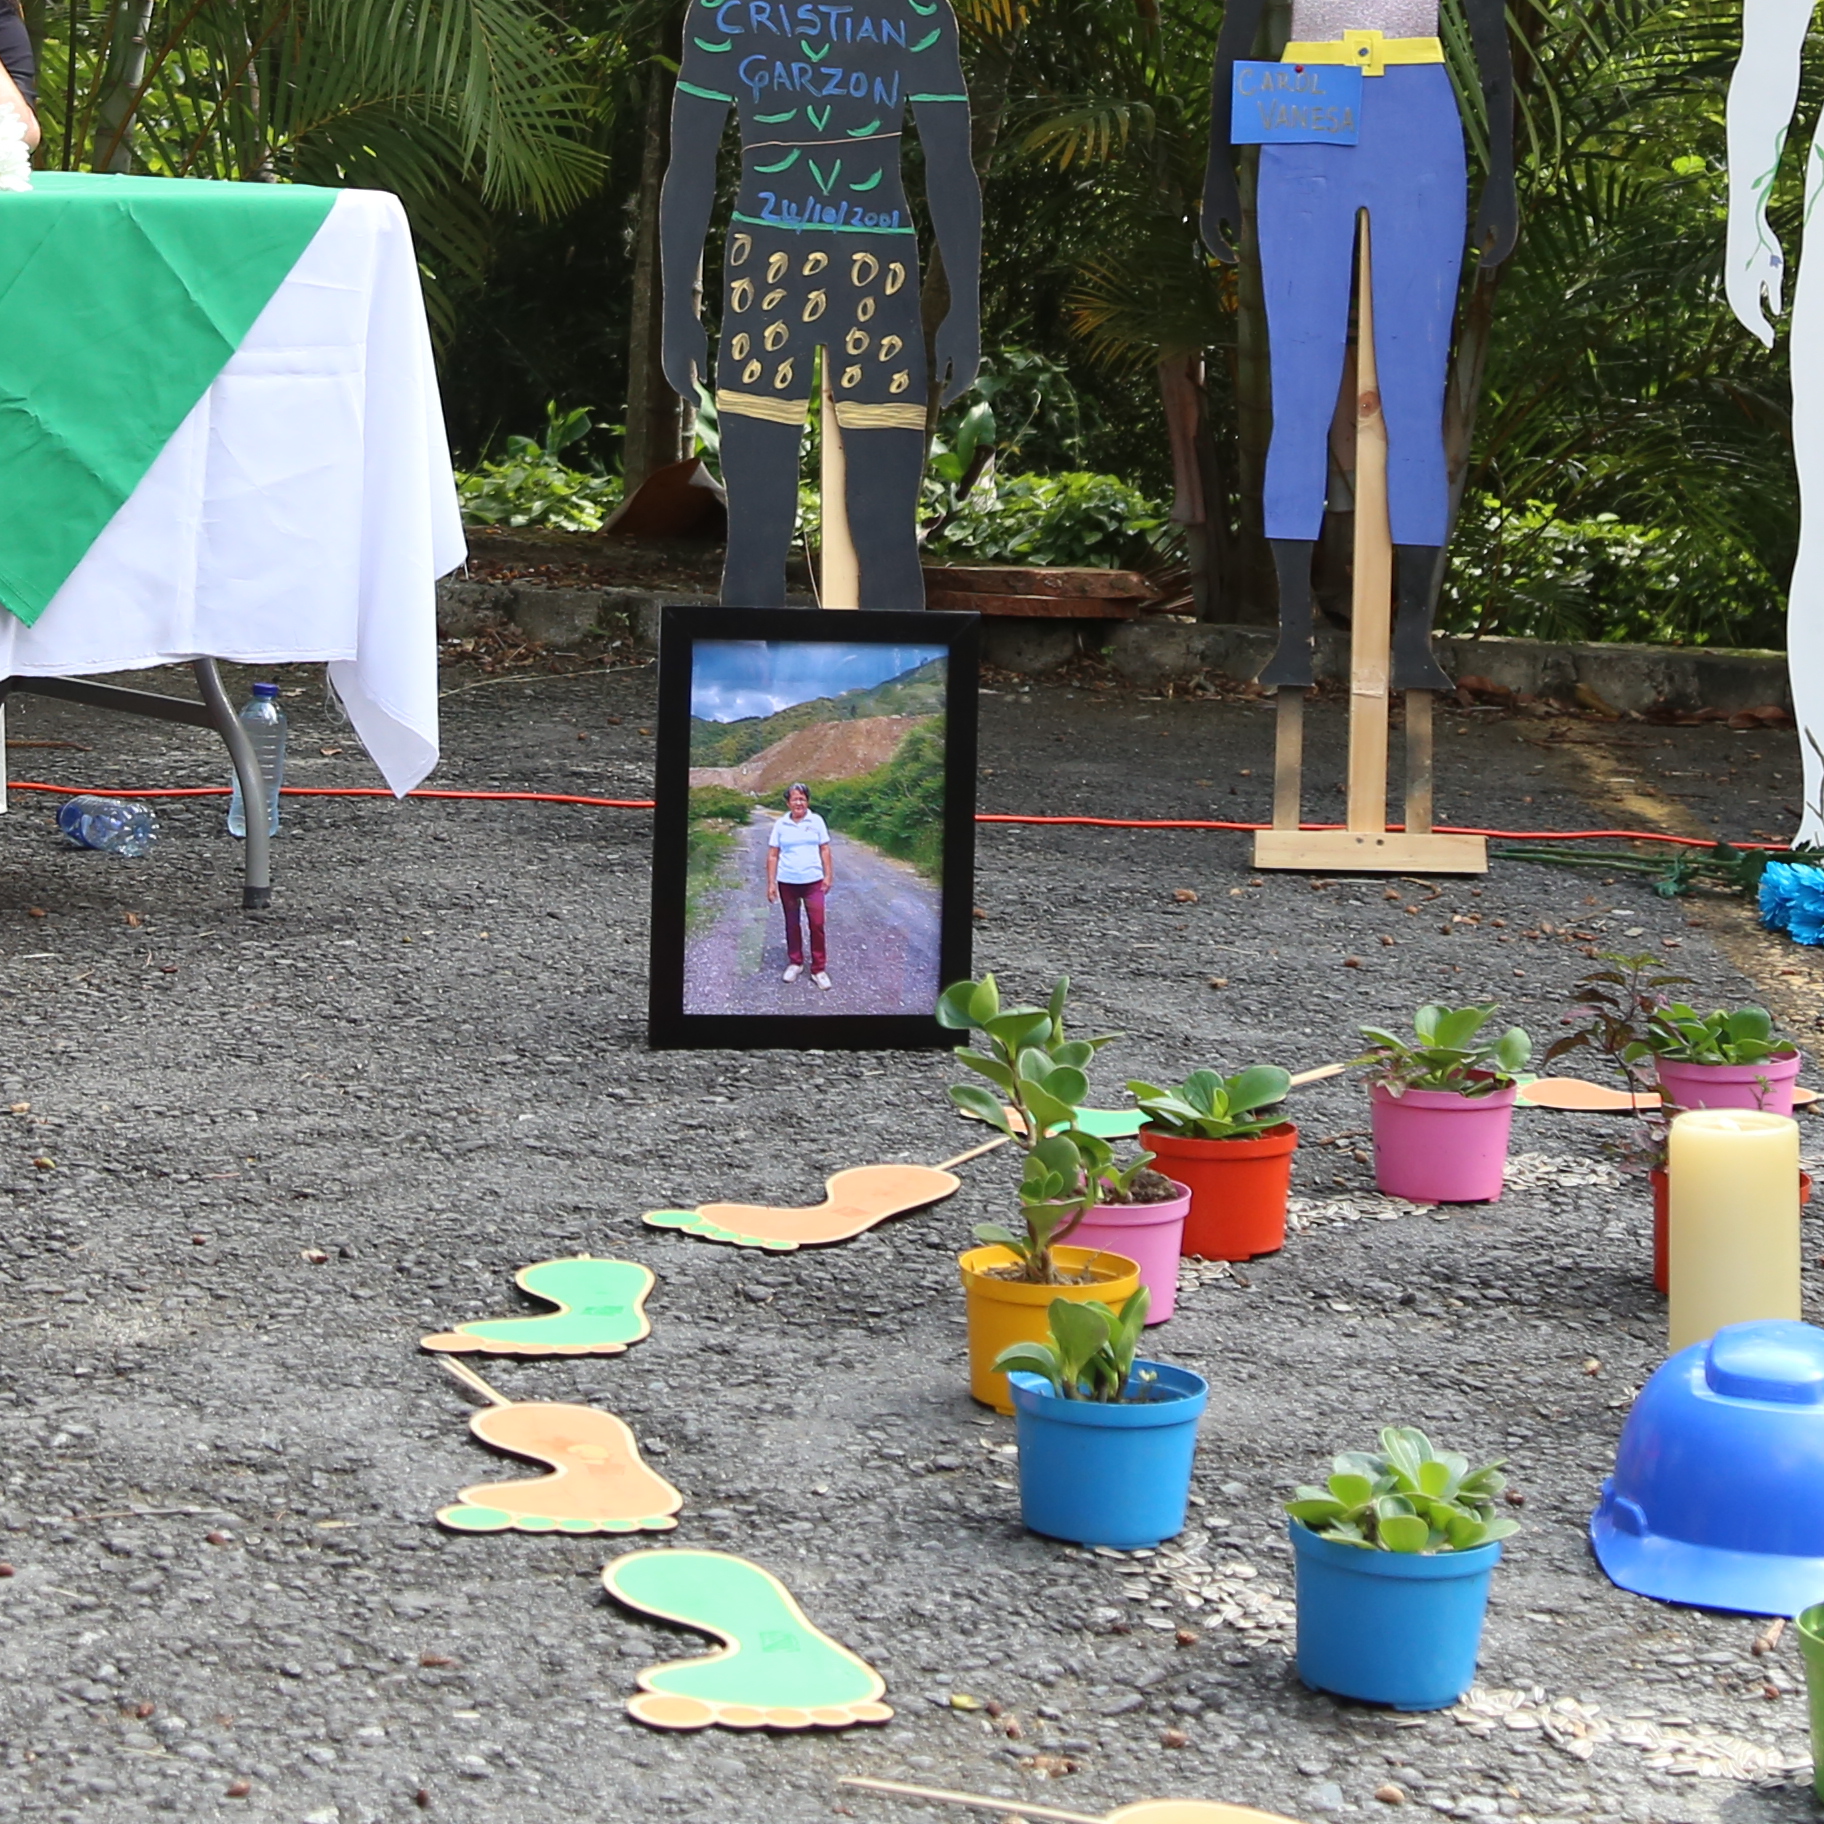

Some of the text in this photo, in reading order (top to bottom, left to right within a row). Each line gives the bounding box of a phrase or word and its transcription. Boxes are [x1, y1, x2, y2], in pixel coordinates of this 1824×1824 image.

[738, 53, 901, 109] GARZON
[1237, 67, 1327, 97] CAROL
[1256, 98, 1356, 134] VANESA
